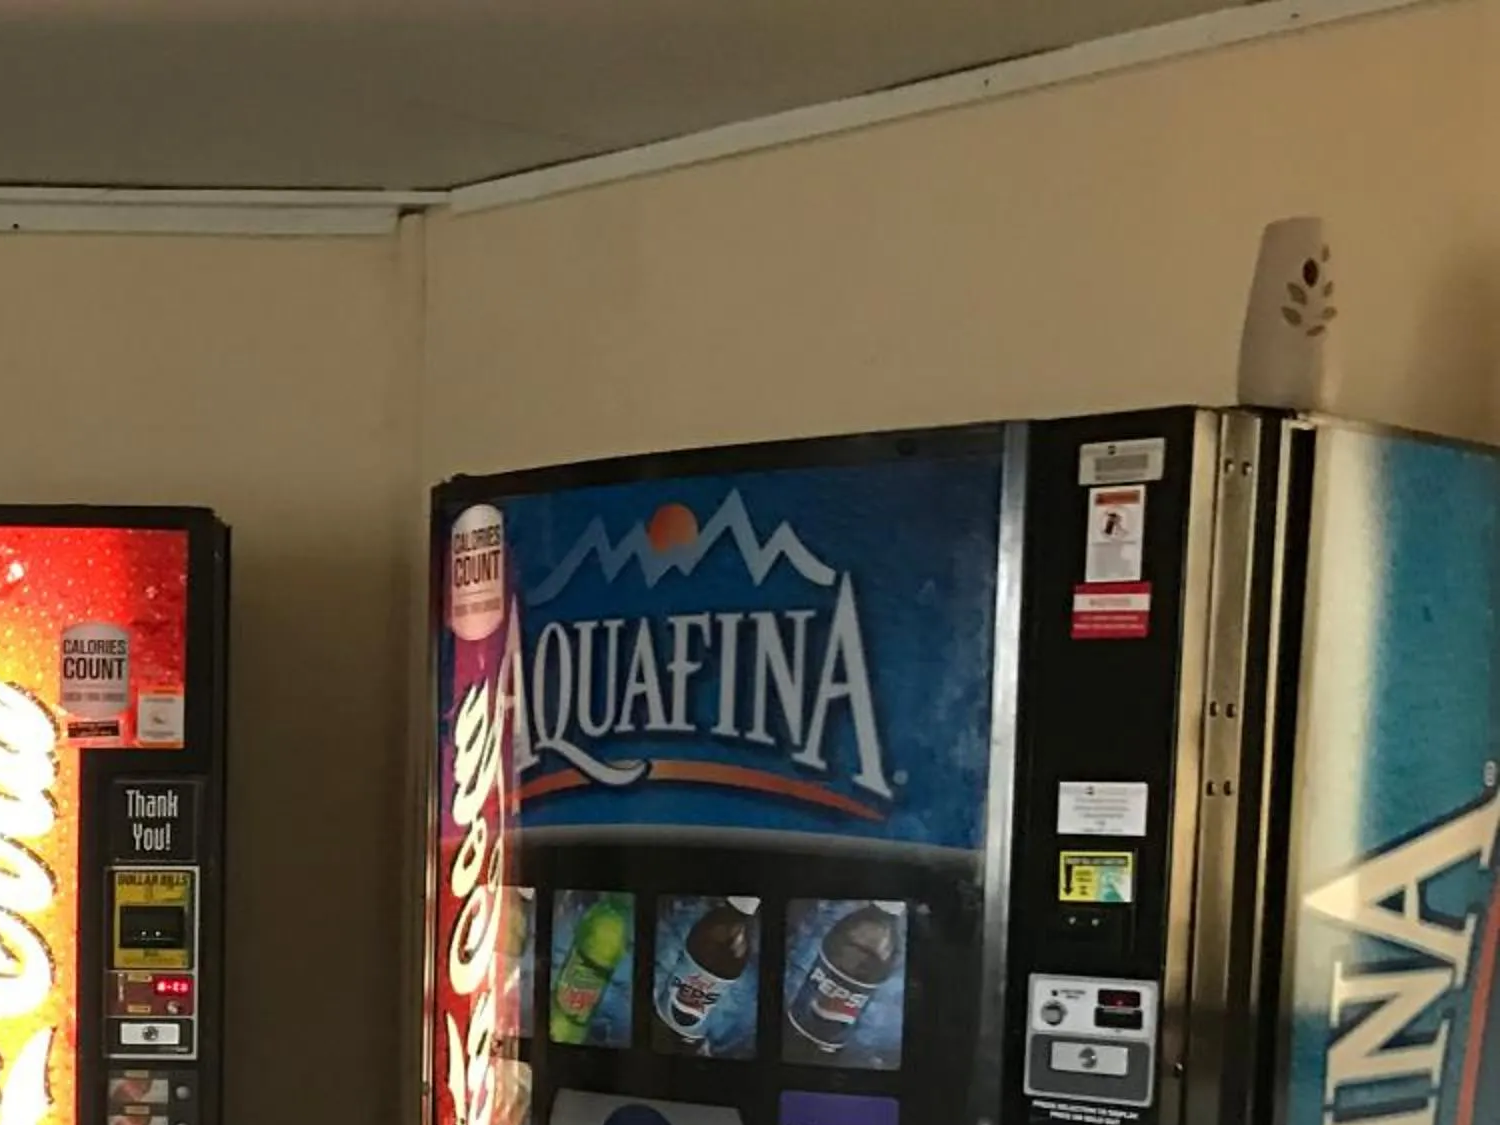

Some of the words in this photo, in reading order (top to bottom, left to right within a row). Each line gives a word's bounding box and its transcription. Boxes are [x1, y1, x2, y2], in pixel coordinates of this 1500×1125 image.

[454, 524, 500, 554] CALORIES
[454, 550, 500, 587] COUNT
[62, 639, 126, 655] CALORIES
[62, 657, 125, 680] COUNT
[493, 571, 895, 799] AQUAFINA
[125, 789, 178, 818] Thank
[133, 823, 171, 851] You!
[809, 968, 870, 1009] PEPSI
